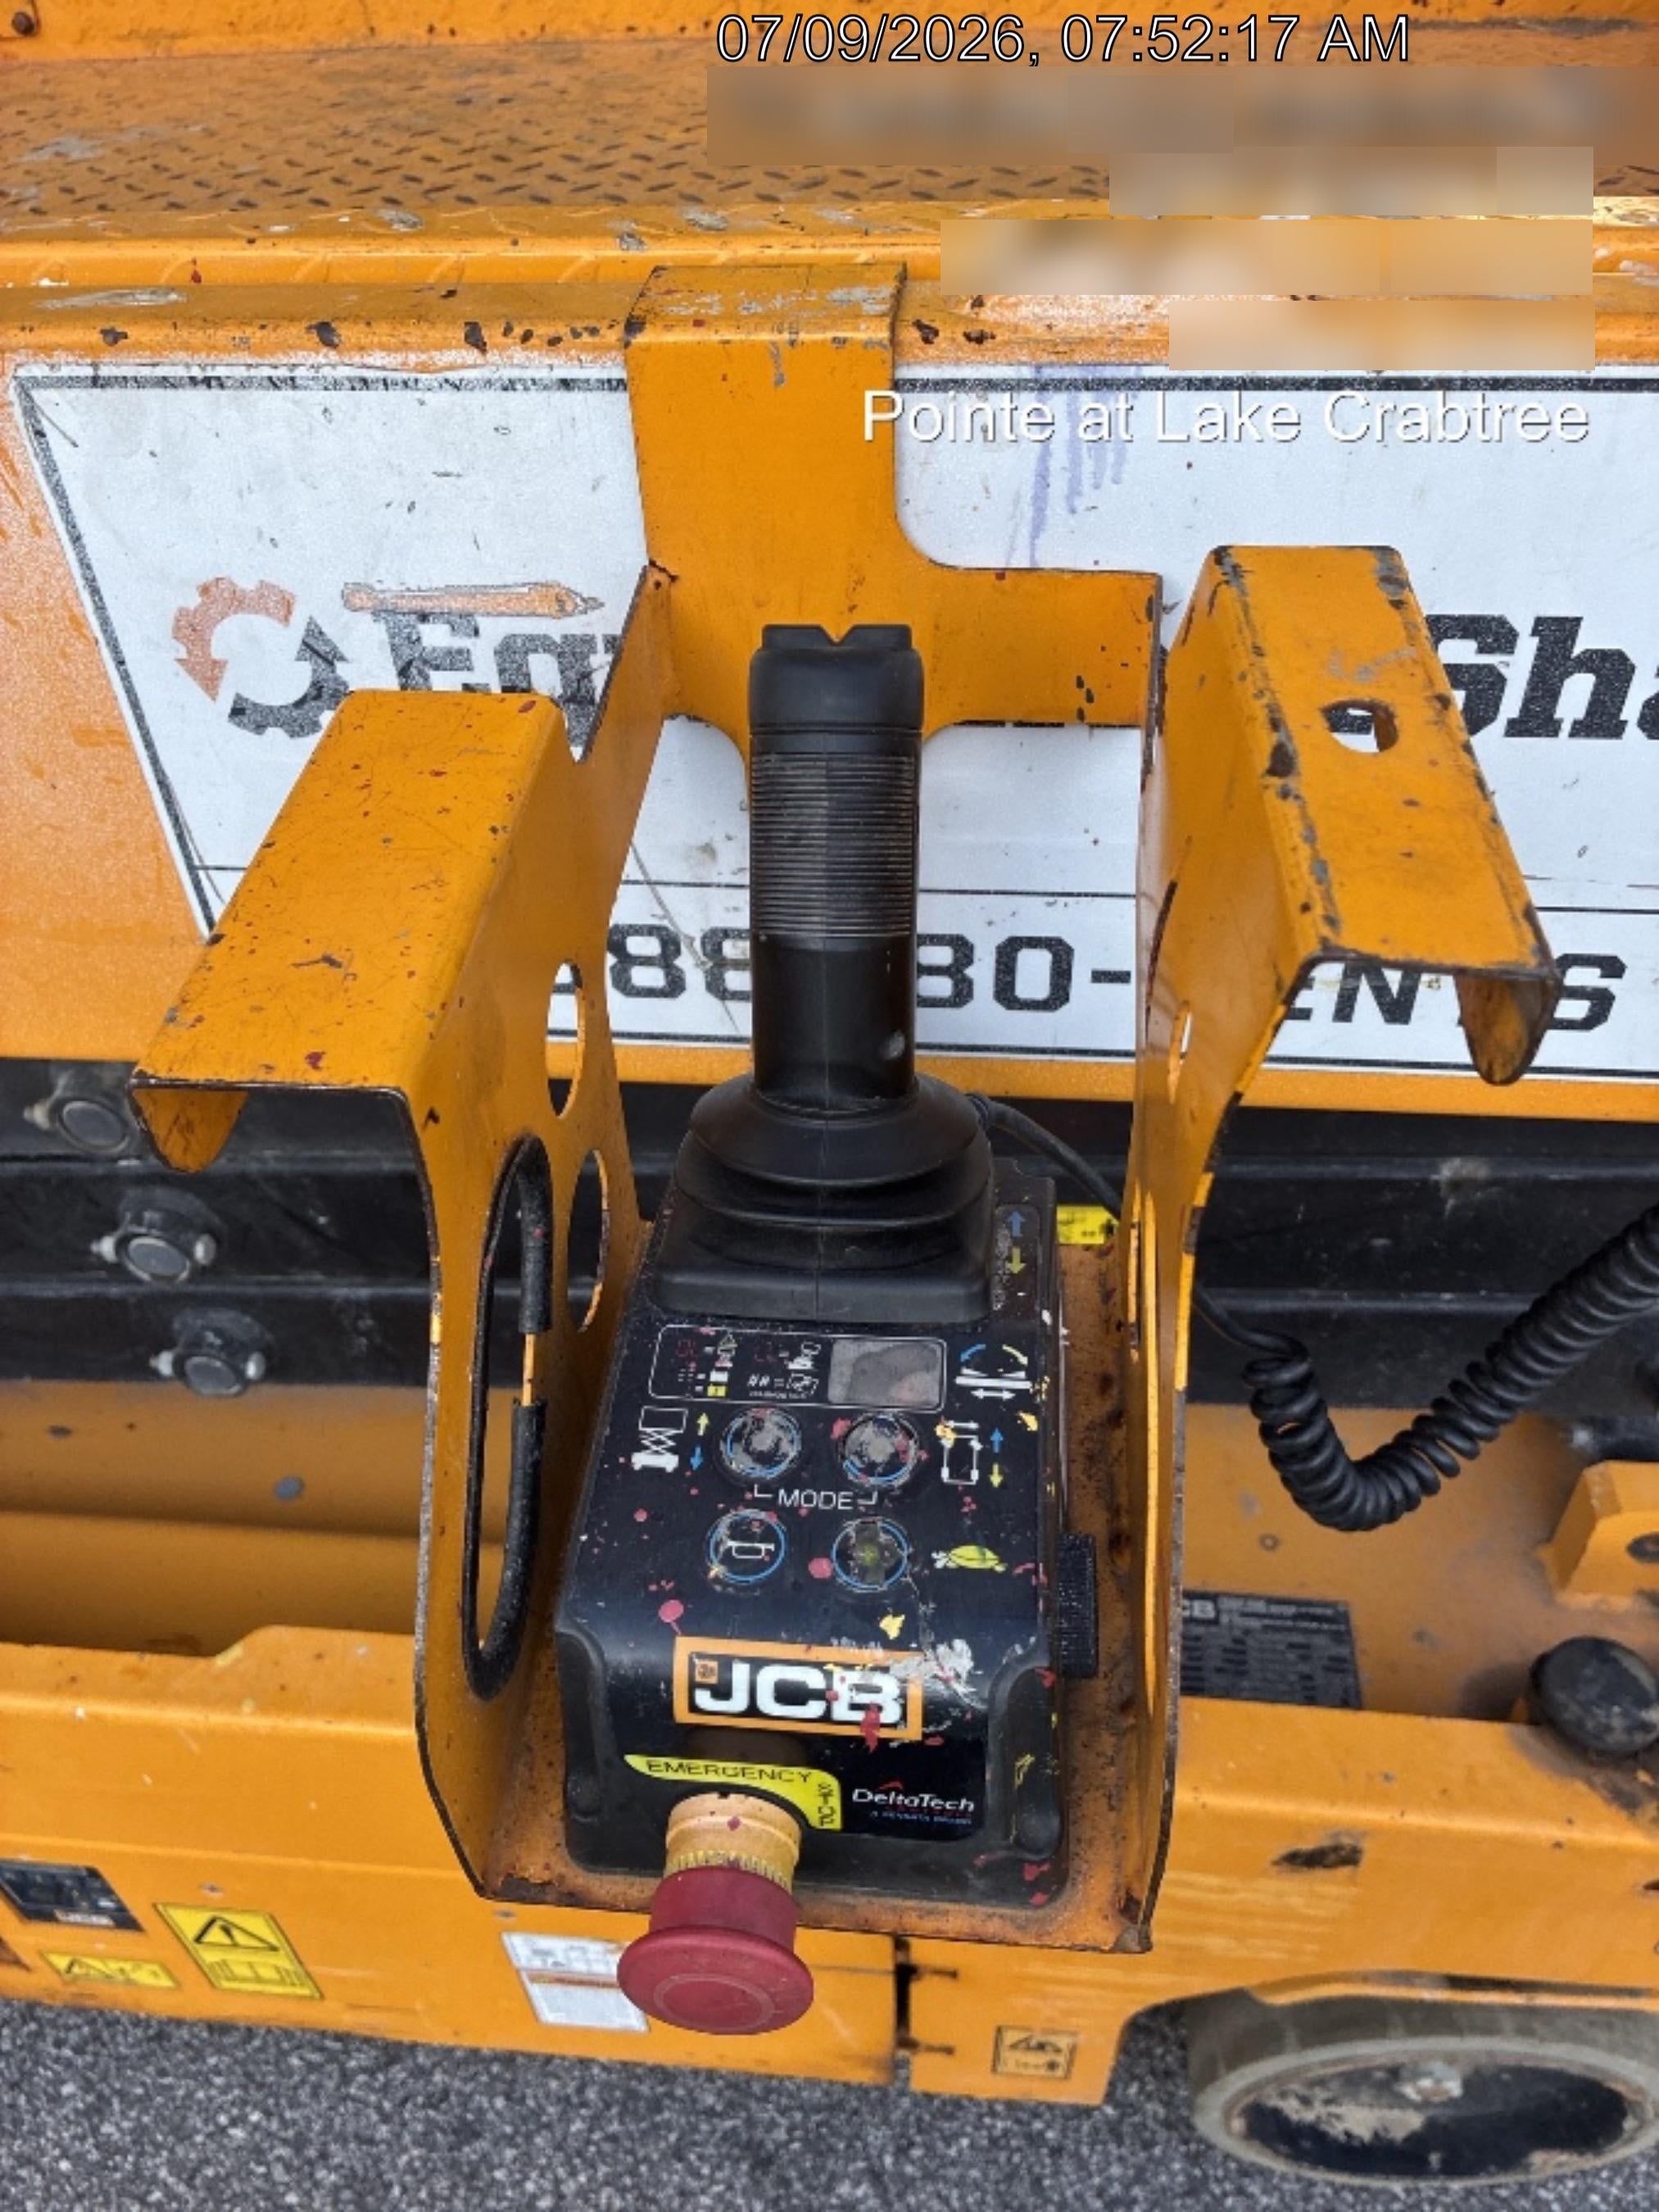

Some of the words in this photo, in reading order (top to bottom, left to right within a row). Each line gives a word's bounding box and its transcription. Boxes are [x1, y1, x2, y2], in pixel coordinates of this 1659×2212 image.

[777, 1489, 854, 1511] MODE
[694, 1661, 902, 1725] JCB
[646, 1760, 812, 1783] EMERGENCY
[817, 1782, 836, 1827] STOP
[852, 1788, 975, 1812] DeltaTech
